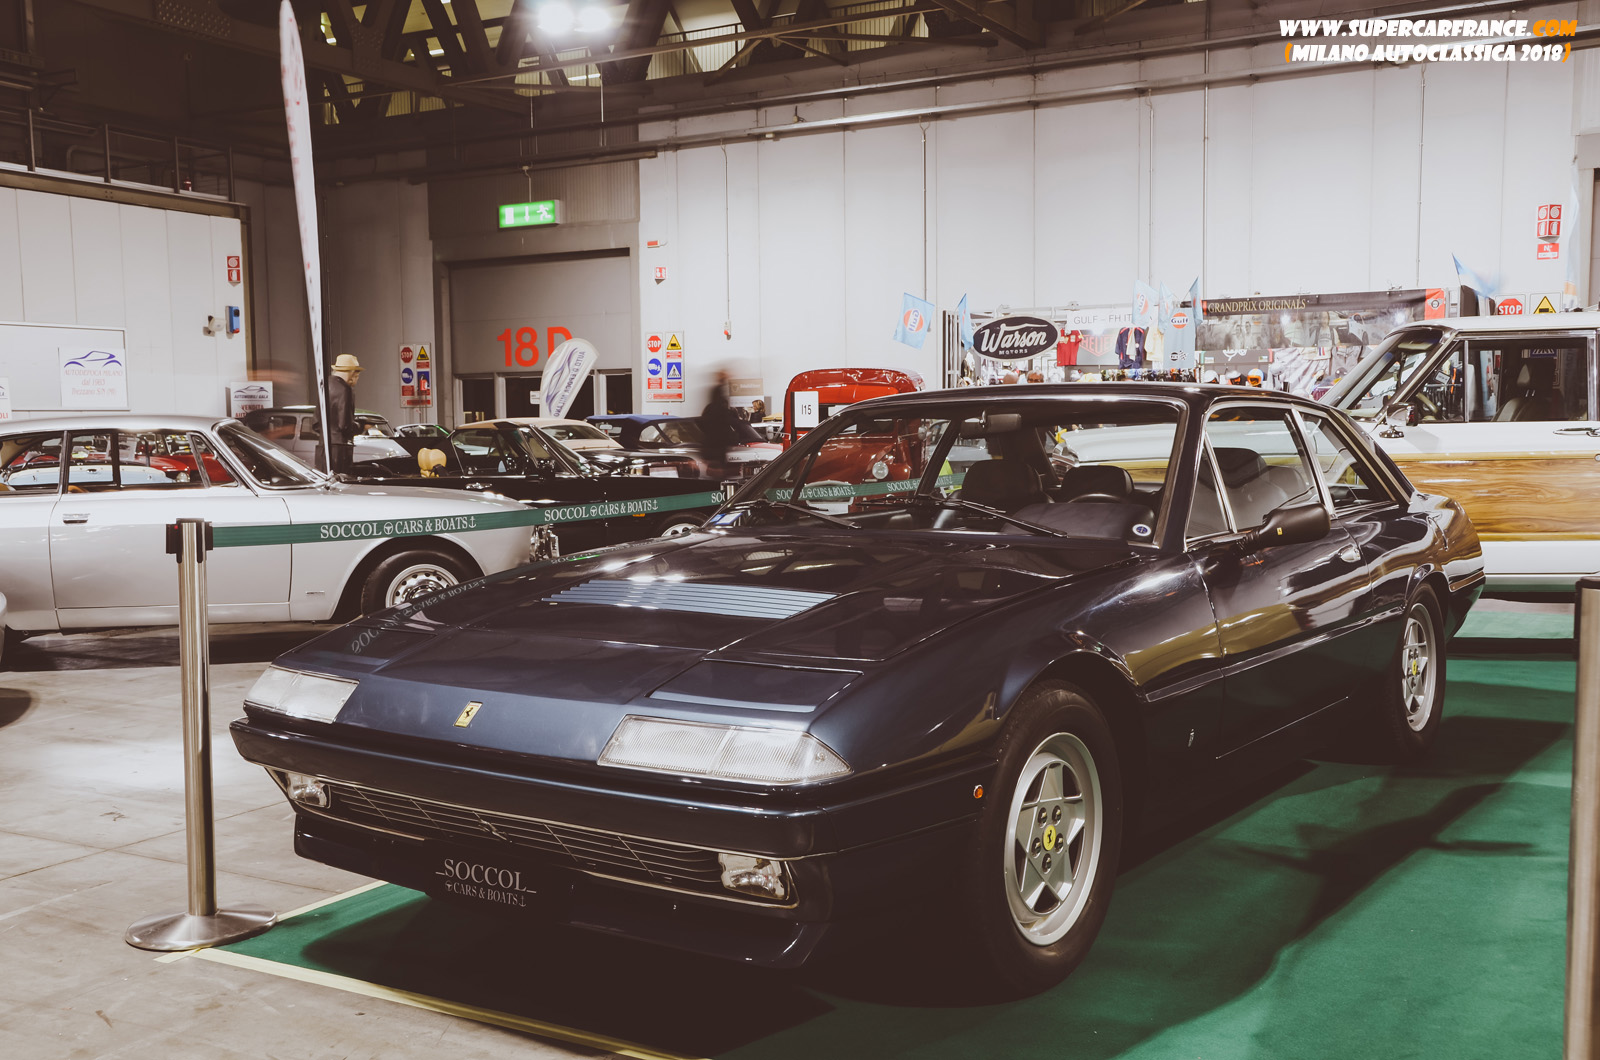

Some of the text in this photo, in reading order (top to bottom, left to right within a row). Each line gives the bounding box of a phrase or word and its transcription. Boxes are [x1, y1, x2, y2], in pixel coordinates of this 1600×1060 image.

[1207, 299, 1306, 313] GRANDPRIX ORIGINALS
[1498, 305, 1522, 315] STOP
[1073, 315, 1098, 324] GULF
[1109, 314, 1121, 323] FH
[497, 326, 573, 367] 18 D
[980, 323, 1048, 353] Warson
[401, 351, 413, 359] STOP
[776, 488, 808, 500] SOCL
[833, 486, 851, 497] BOATS
[887, 481, 913, 492] SOCCOL
[544, 500, 652, 522] SOCCOL CARS & BOATS
[320, 516, 468, 539] SOCCOL CARS & BOATS
[444, 858, 527, 891] SOCCOL
[453, 882, 518, 906] CARS & BOATS
